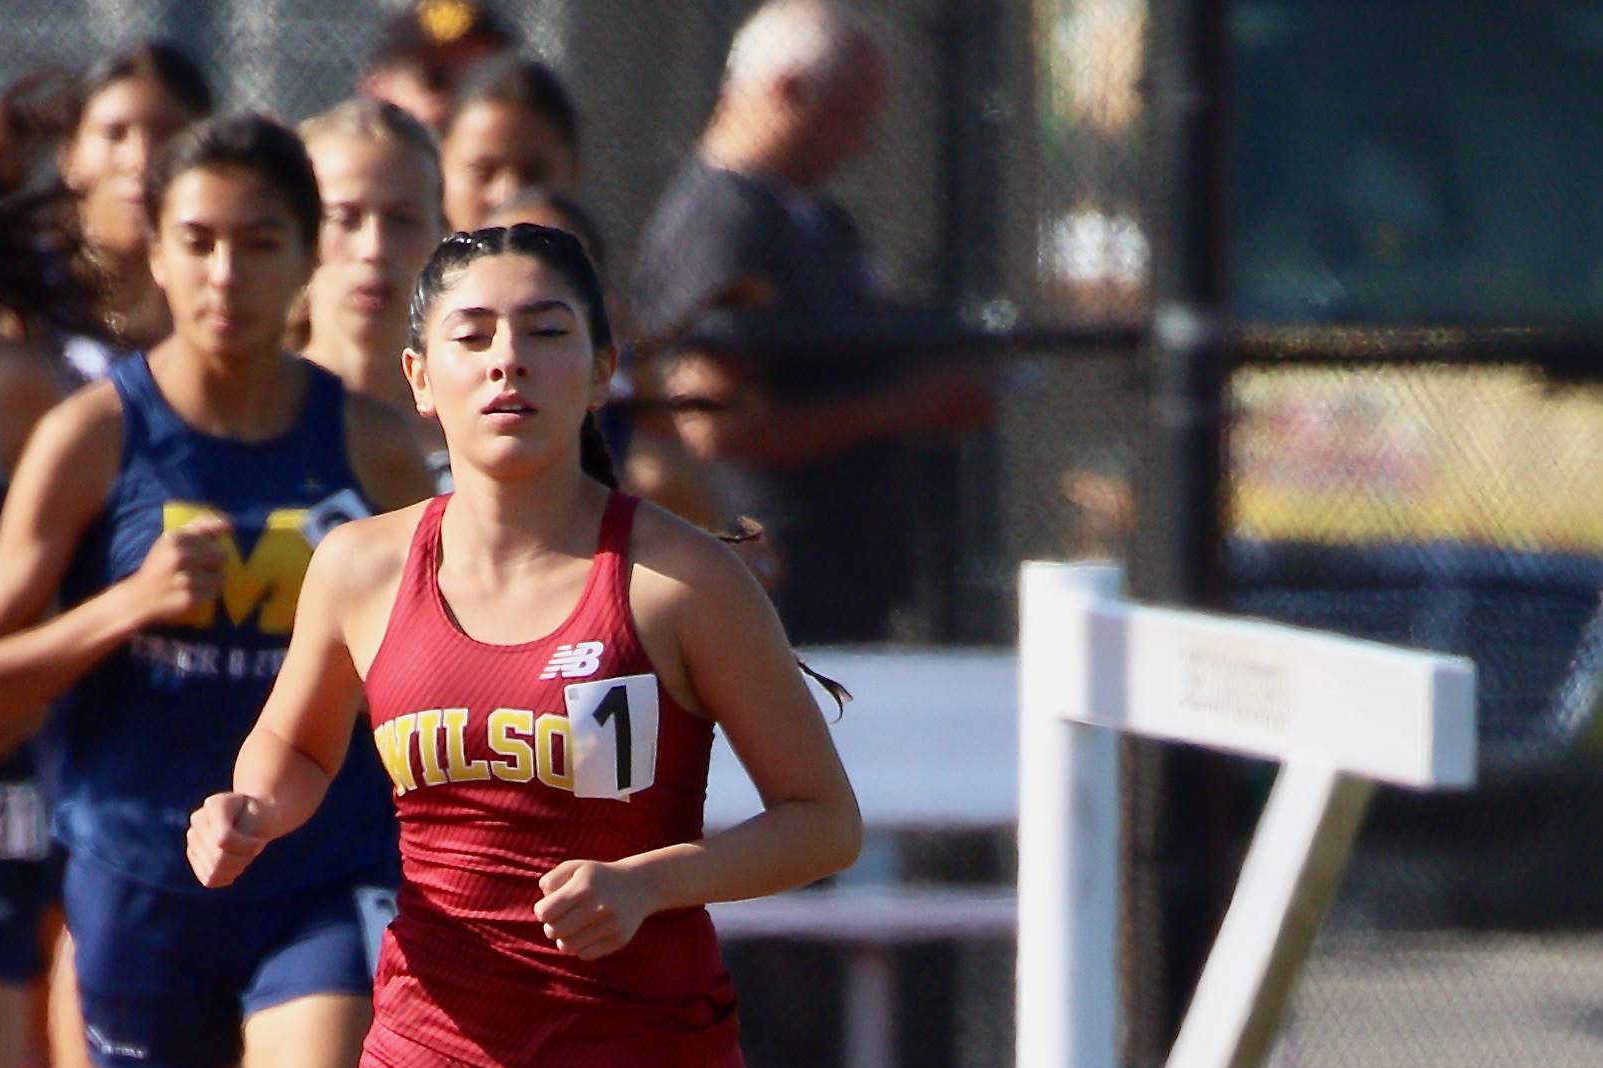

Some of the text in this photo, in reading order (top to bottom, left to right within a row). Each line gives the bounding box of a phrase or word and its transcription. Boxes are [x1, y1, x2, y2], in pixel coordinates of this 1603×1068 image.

[156, 502, 312, 636] M
[374, 707, 575, 797] WILSO
[592, 684, 632, 792] 1
